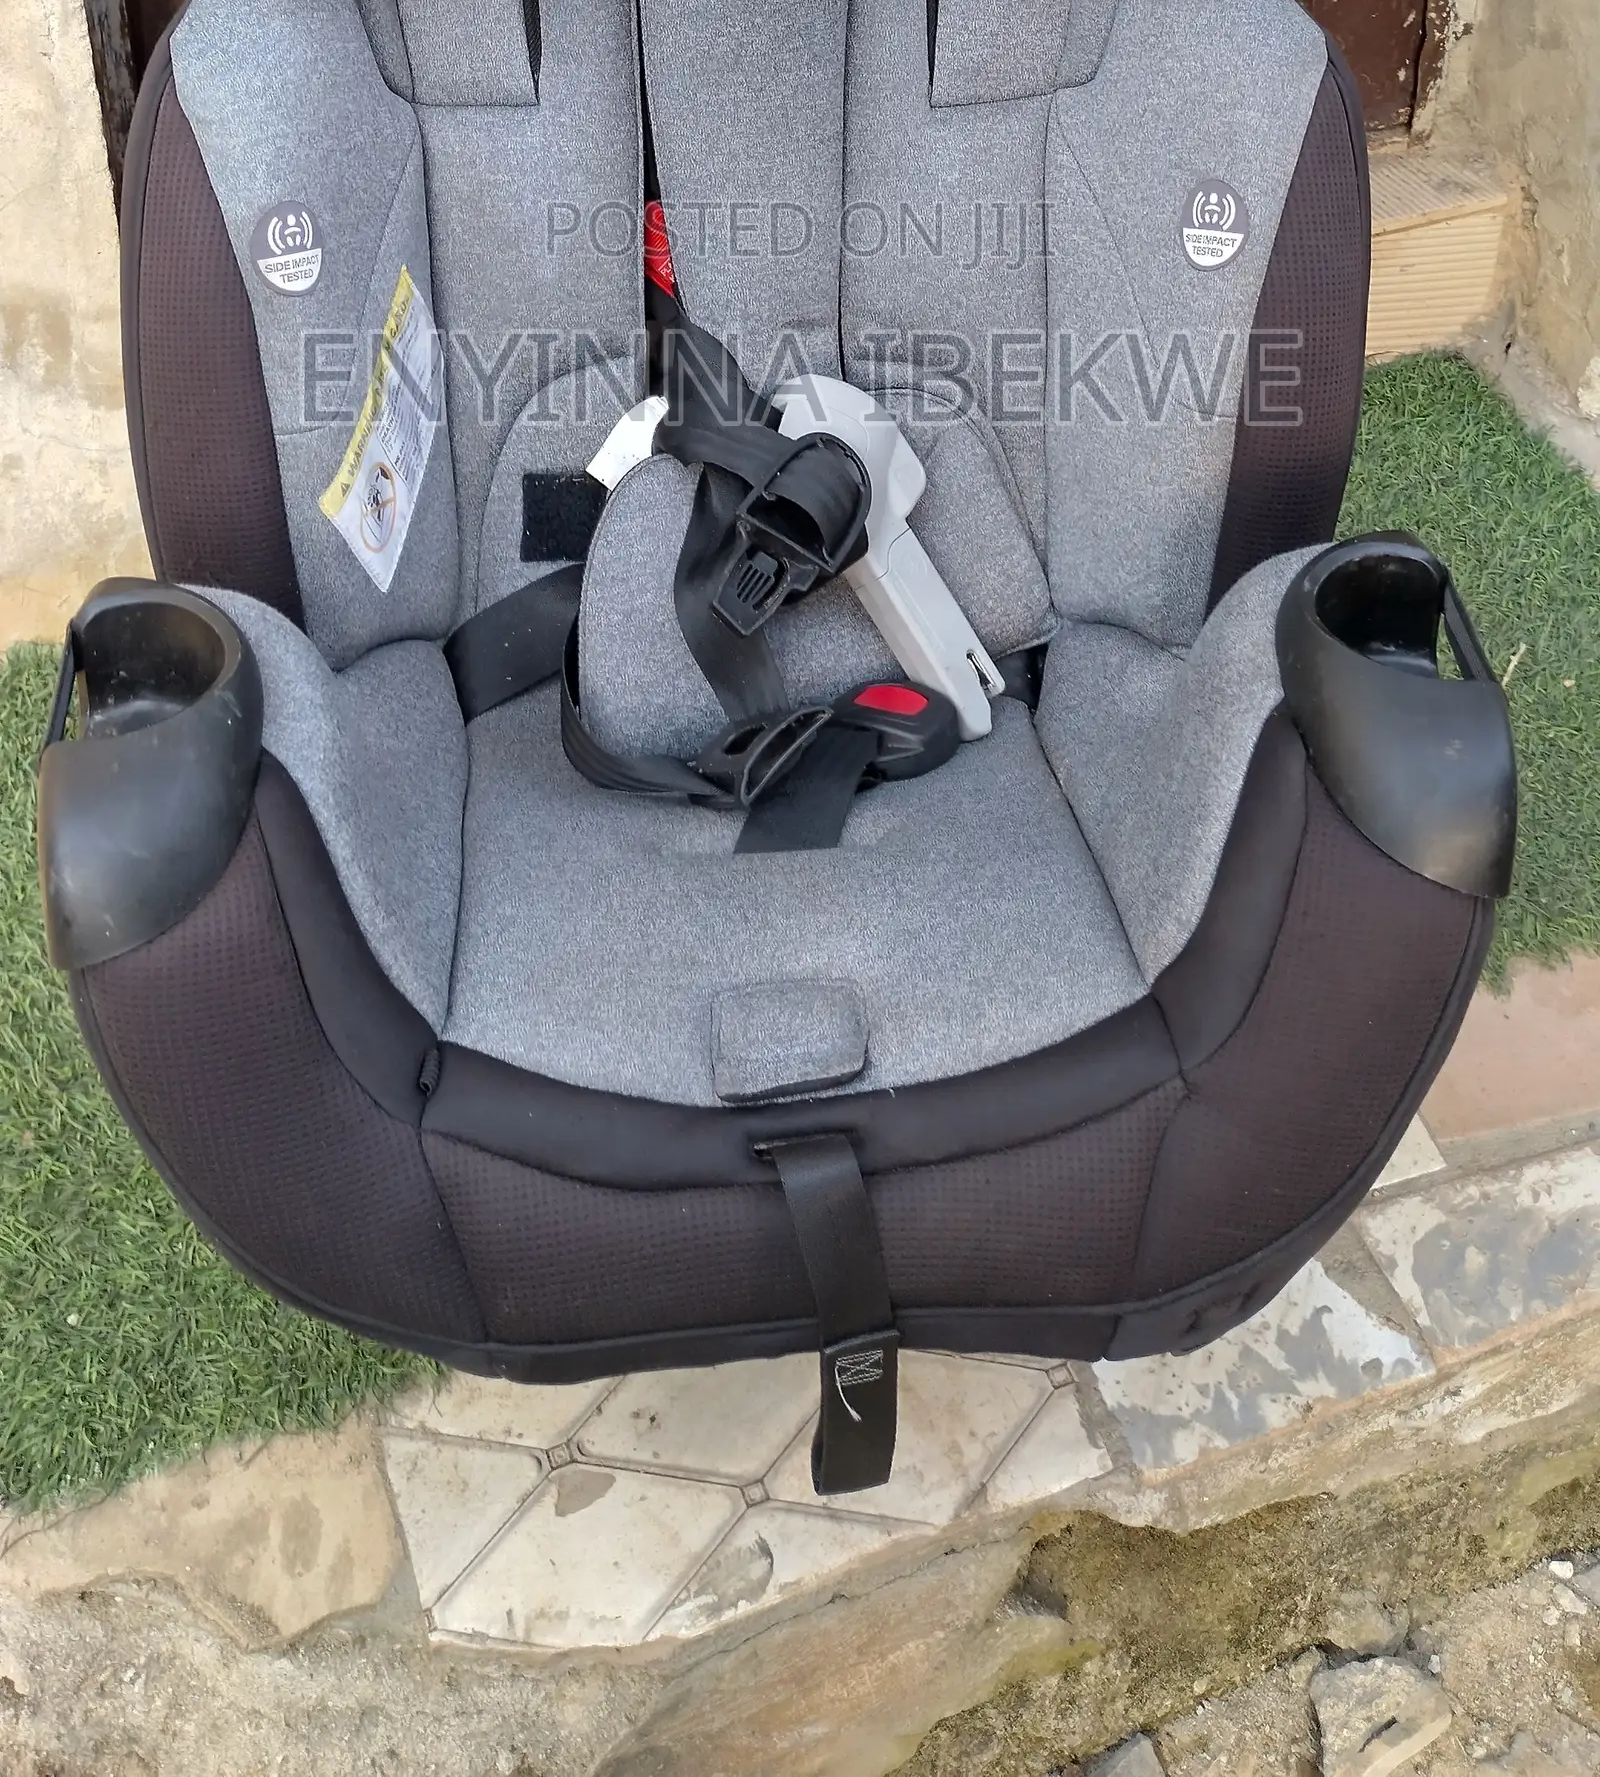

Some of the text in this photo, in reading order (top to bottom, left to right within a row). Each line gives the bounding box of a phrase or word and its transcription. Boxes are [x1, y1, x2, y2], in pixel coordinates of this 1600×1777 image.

[1202, 234, 1237, 248] IMPACT
[1192, 245, 1223, 258] TESTED
[264, 253, 320, 274] SIDE IMPACT
[279, 268, 314, 284] TESTED
